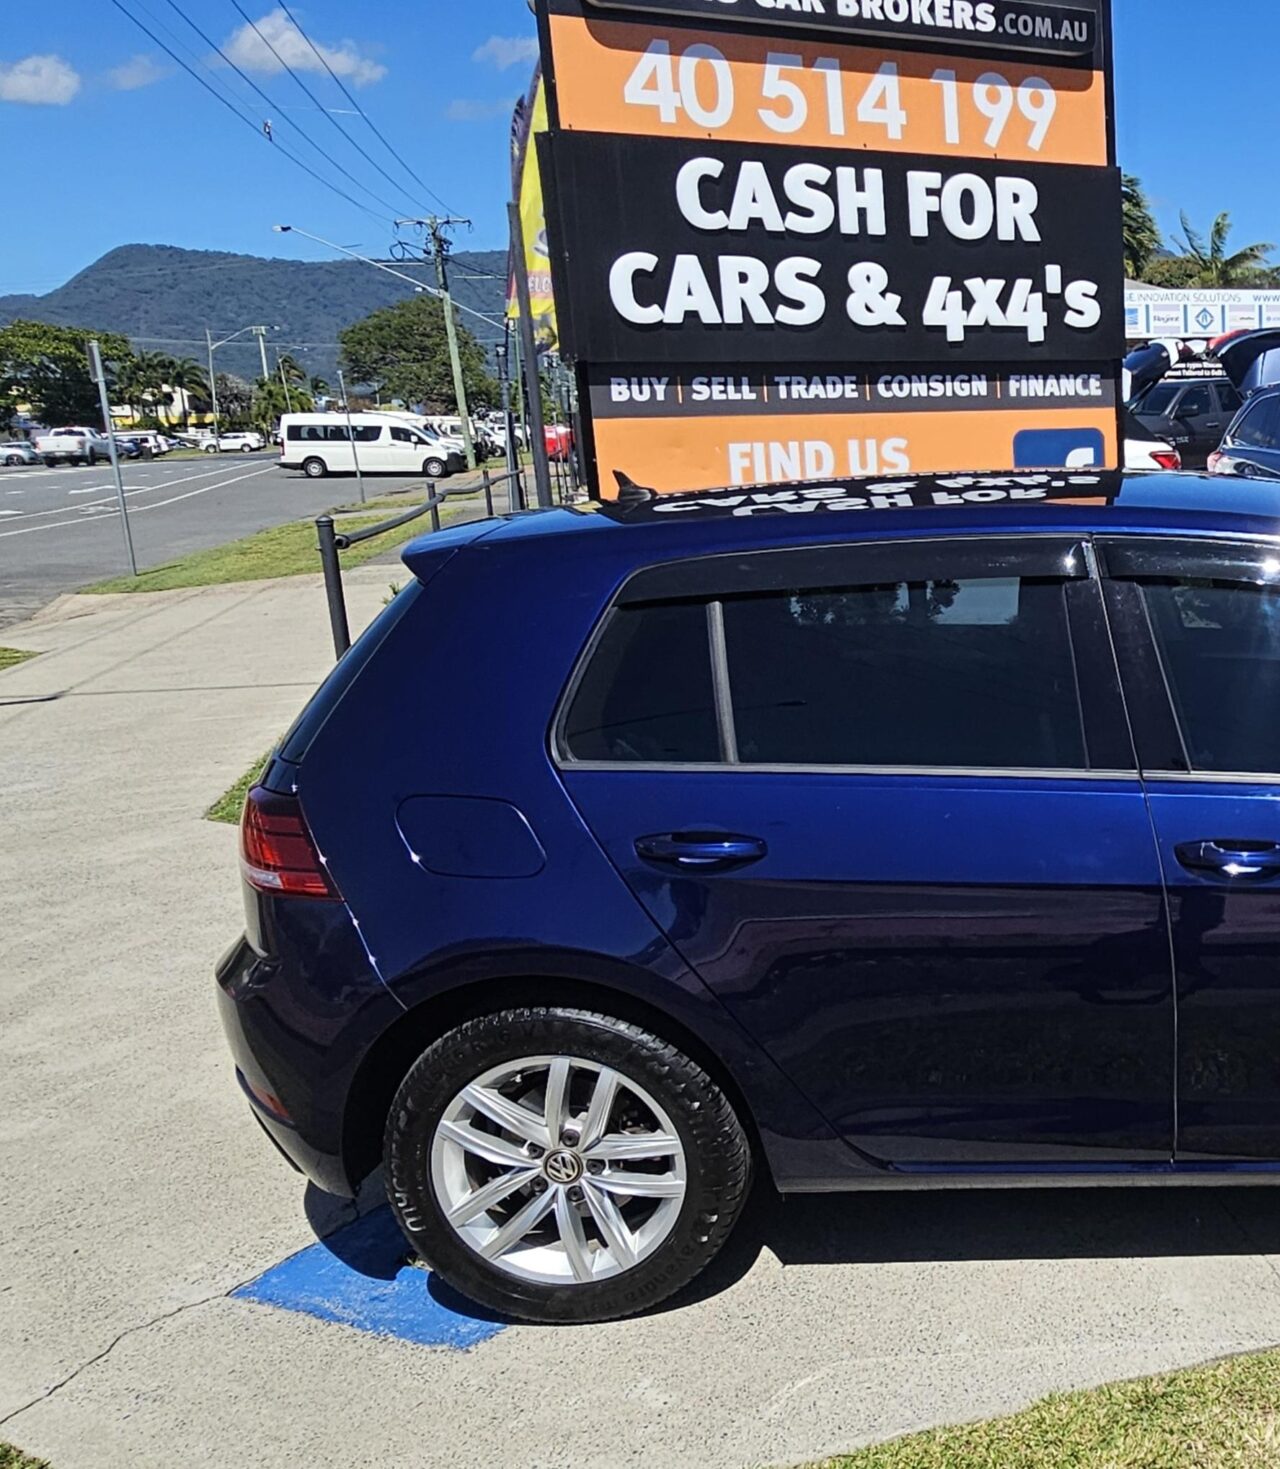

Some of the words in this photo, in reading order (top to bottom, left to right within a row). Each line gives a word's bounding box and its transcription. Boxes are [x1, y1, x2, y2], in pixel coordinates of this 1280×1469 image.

[624, 38, 735, 129] 40
[758, 51, 907, 141] 514
[931, 68, 1058, 152] 199
[676, 157, 888, 237] CASH
[907, 170, 1042, 243] FOR
[608, 251, 827, 326] CARS
[846, 261, 908, 327] &
[1136, 293, 1190, 303] INNOVATION
[1192, 293, 1242, 303] SOLUTIONS
[610, 377, 670, 403] BUY
[691, 377, 757, 402] SELL
[775, 376, 859, 401] TRADE
[877, 375, 988, 399] CONSIGN
[1008, 374, 1103, 398] FINANCE
[727, 440, 835, 486] FIND
[848, 437, 911, 478] US
